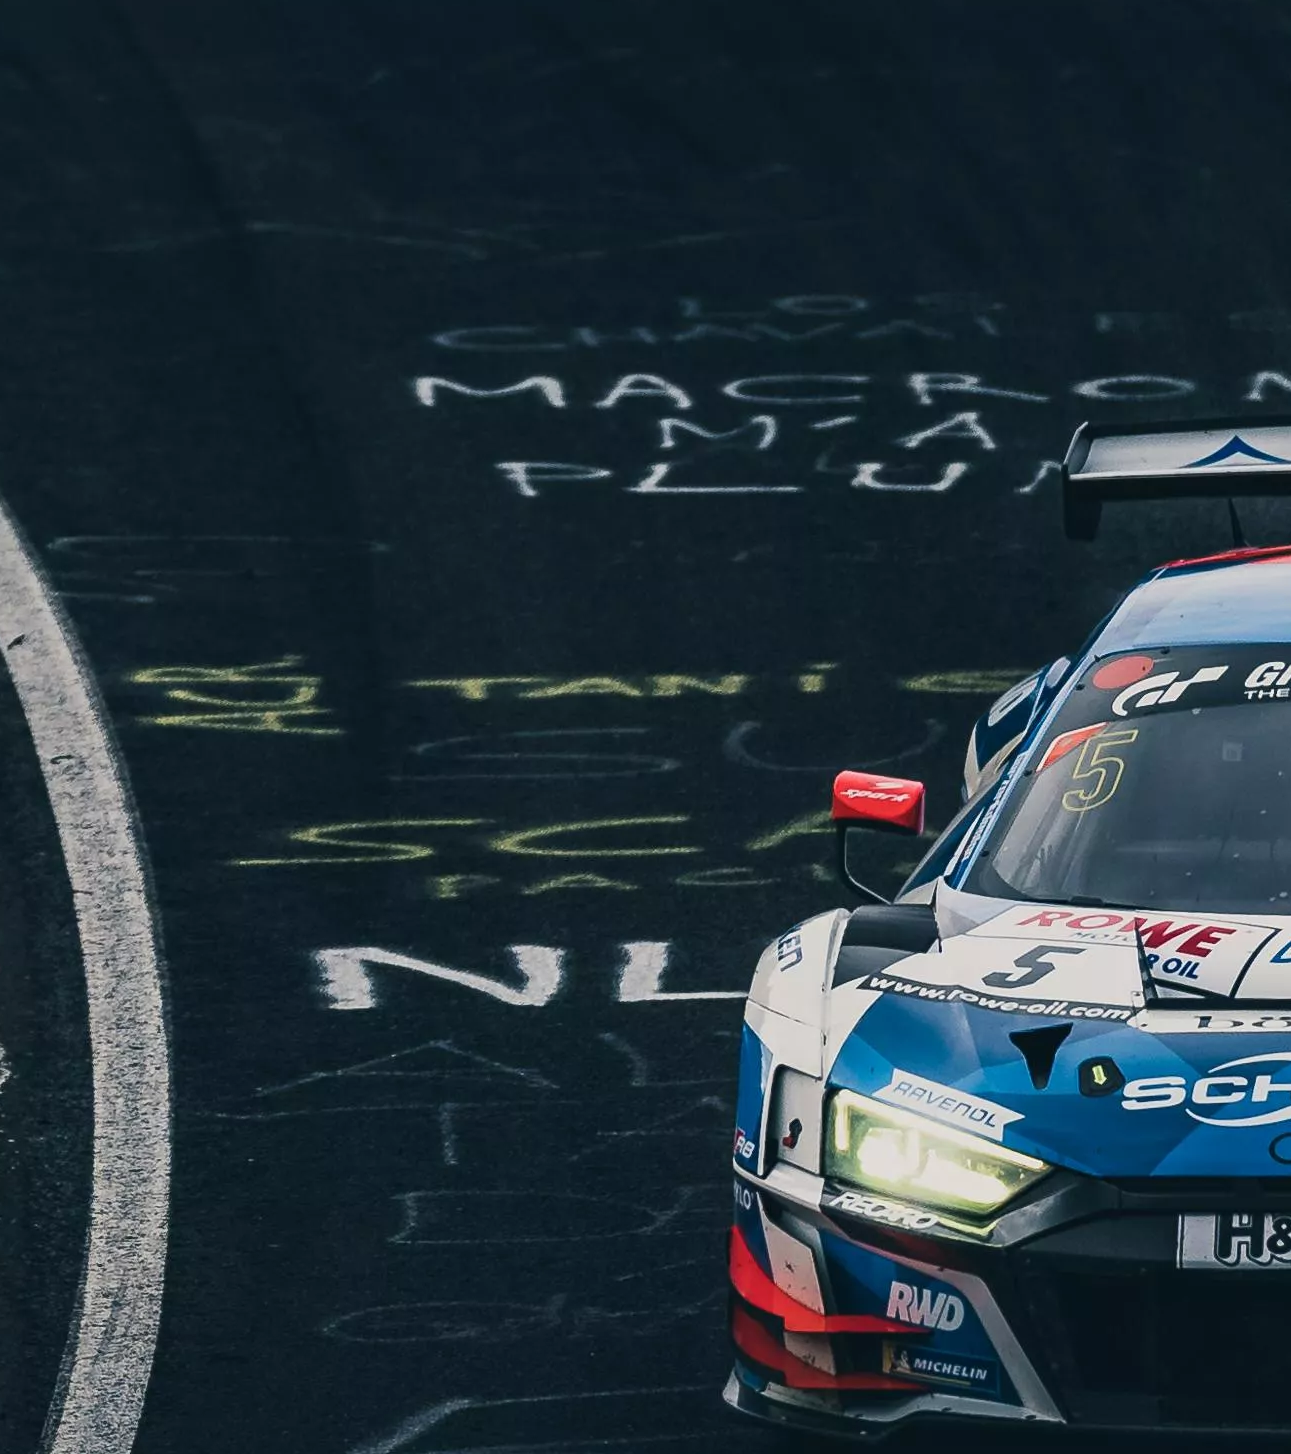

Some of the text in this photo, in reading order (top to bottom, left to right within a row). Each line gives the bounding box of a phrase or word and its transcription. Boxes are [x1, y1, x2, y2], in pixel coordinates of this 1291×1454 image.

[1244, 688, 1290, 700] THE
[1062, 728, 1138, 813] 5
[1016, 909, 1237, 958] ROWE
[982, 944, 1087, 989] 5
[1161, 957, 1200, 980] OIL
[869, 975, 1133, 1020] www.rowe-oil.com
[892, 1081, 997, 1128] RAVENOL
[828, 1191, 940, 1230] RECARO
[887, 1281, 965, 1331] RWD
[914, 1357, 988, 1381] MICHELIN
